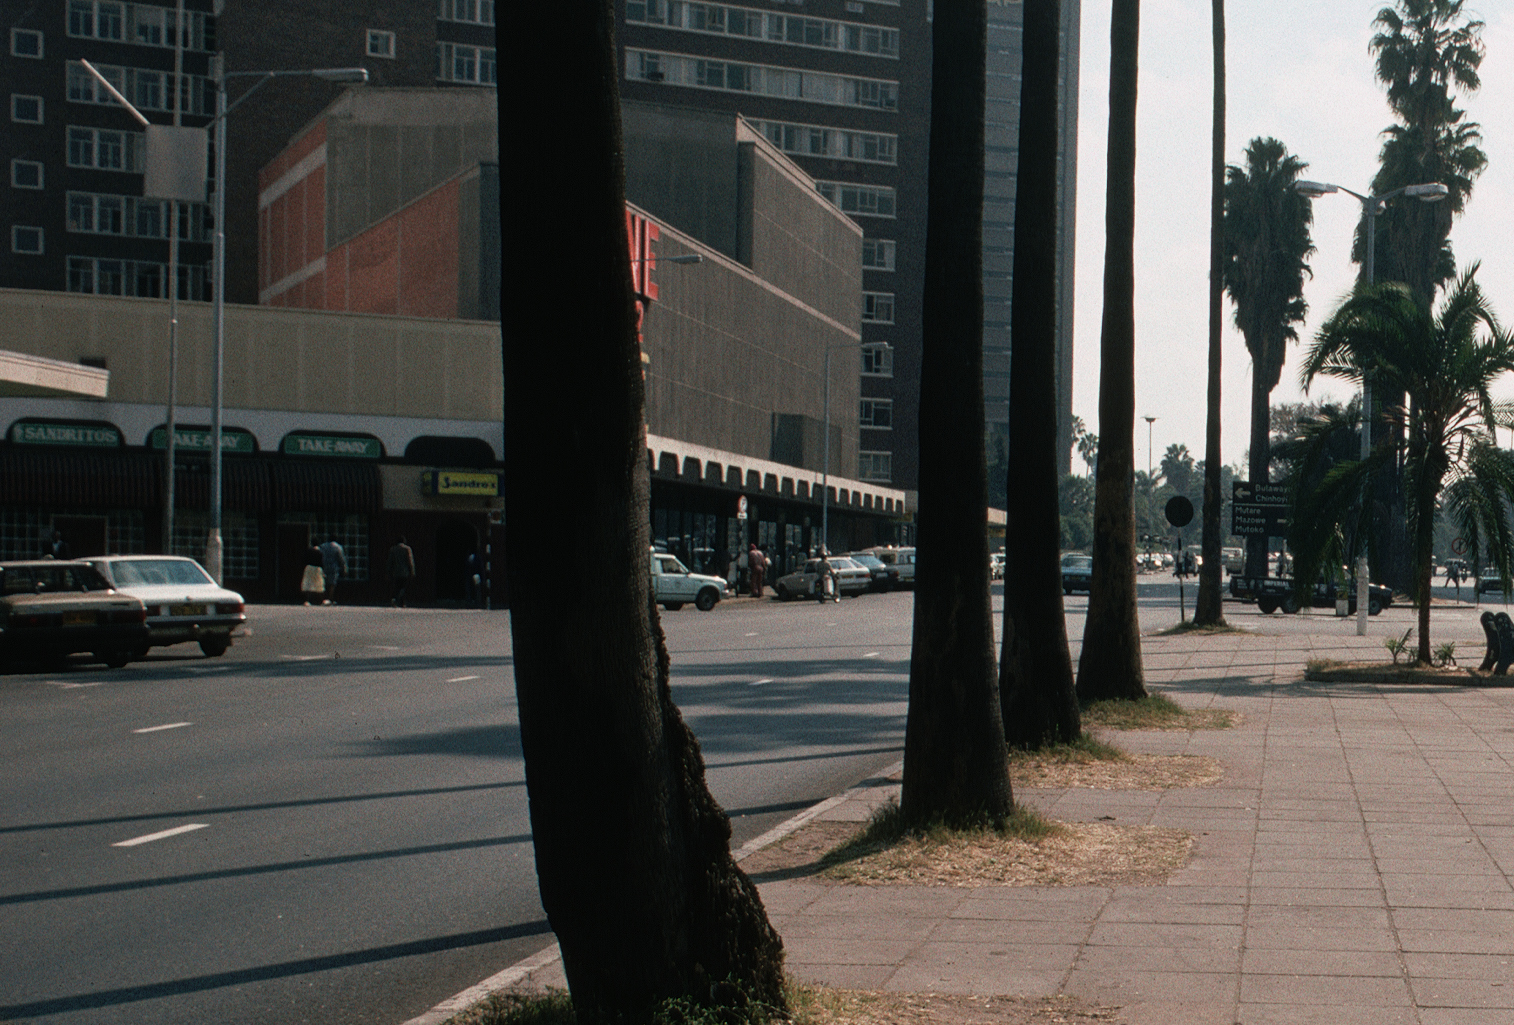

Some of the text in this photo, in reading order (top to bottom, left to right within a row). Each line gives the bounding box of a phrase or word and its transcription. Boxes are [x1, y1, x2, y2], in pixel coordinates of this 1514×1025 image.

[170, 433, 240, 448] AKE-AAY
[297, 437, 368, 454] TAKE-AWAY
[1255, 484, 1289, 493] Bulaway
[1235, 507, 1261, 515] Mutare
[1235, 516, 1266, 524] Mazowe
[1235, 525, 1264, 534] Mutoko
